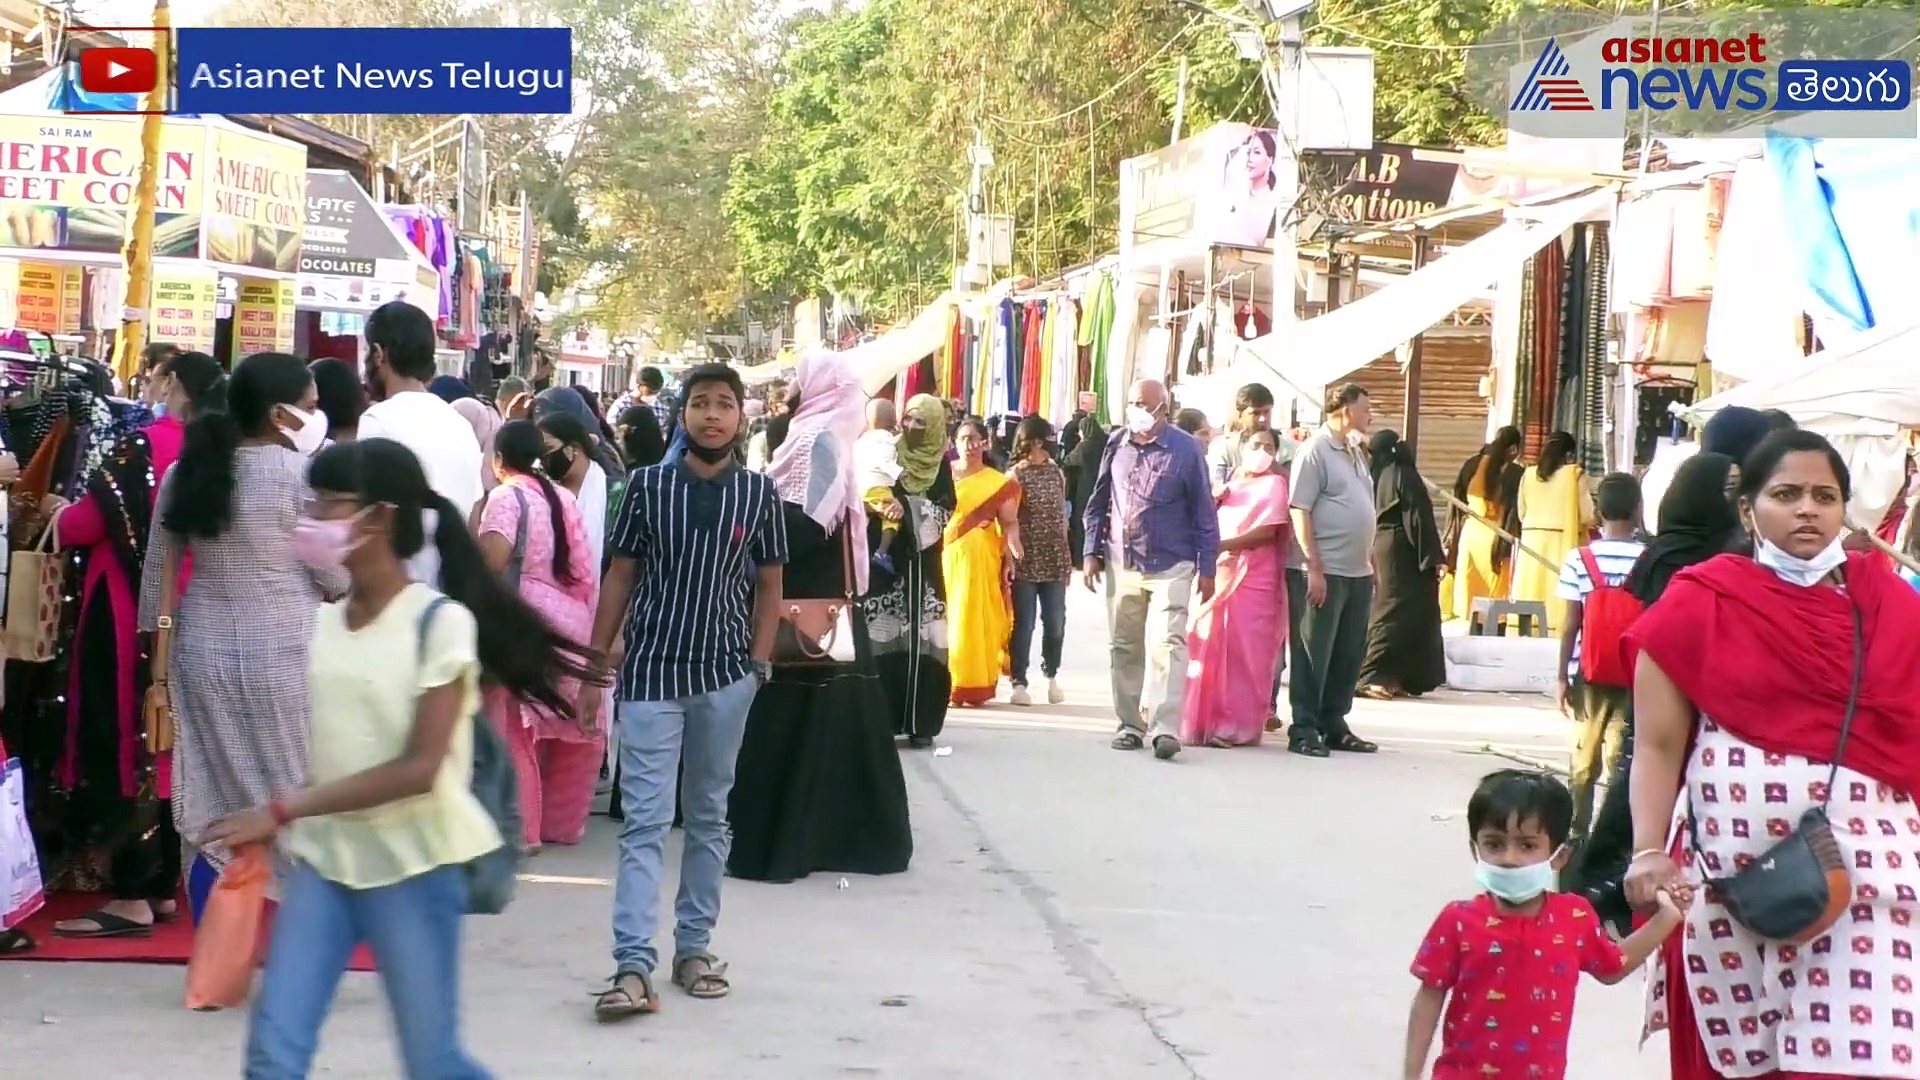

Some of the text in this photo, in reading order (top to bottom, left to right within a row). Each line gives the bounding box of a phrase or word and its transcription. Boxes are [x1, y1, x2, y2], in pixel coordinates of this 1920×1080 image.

[39, 127, 92, 138] SAI RAM
[0, 142, 193, 180] ERICN
[215, 190, 298, 226] SWEET CORN
[301, 258, 373, 274] OCOLATES
